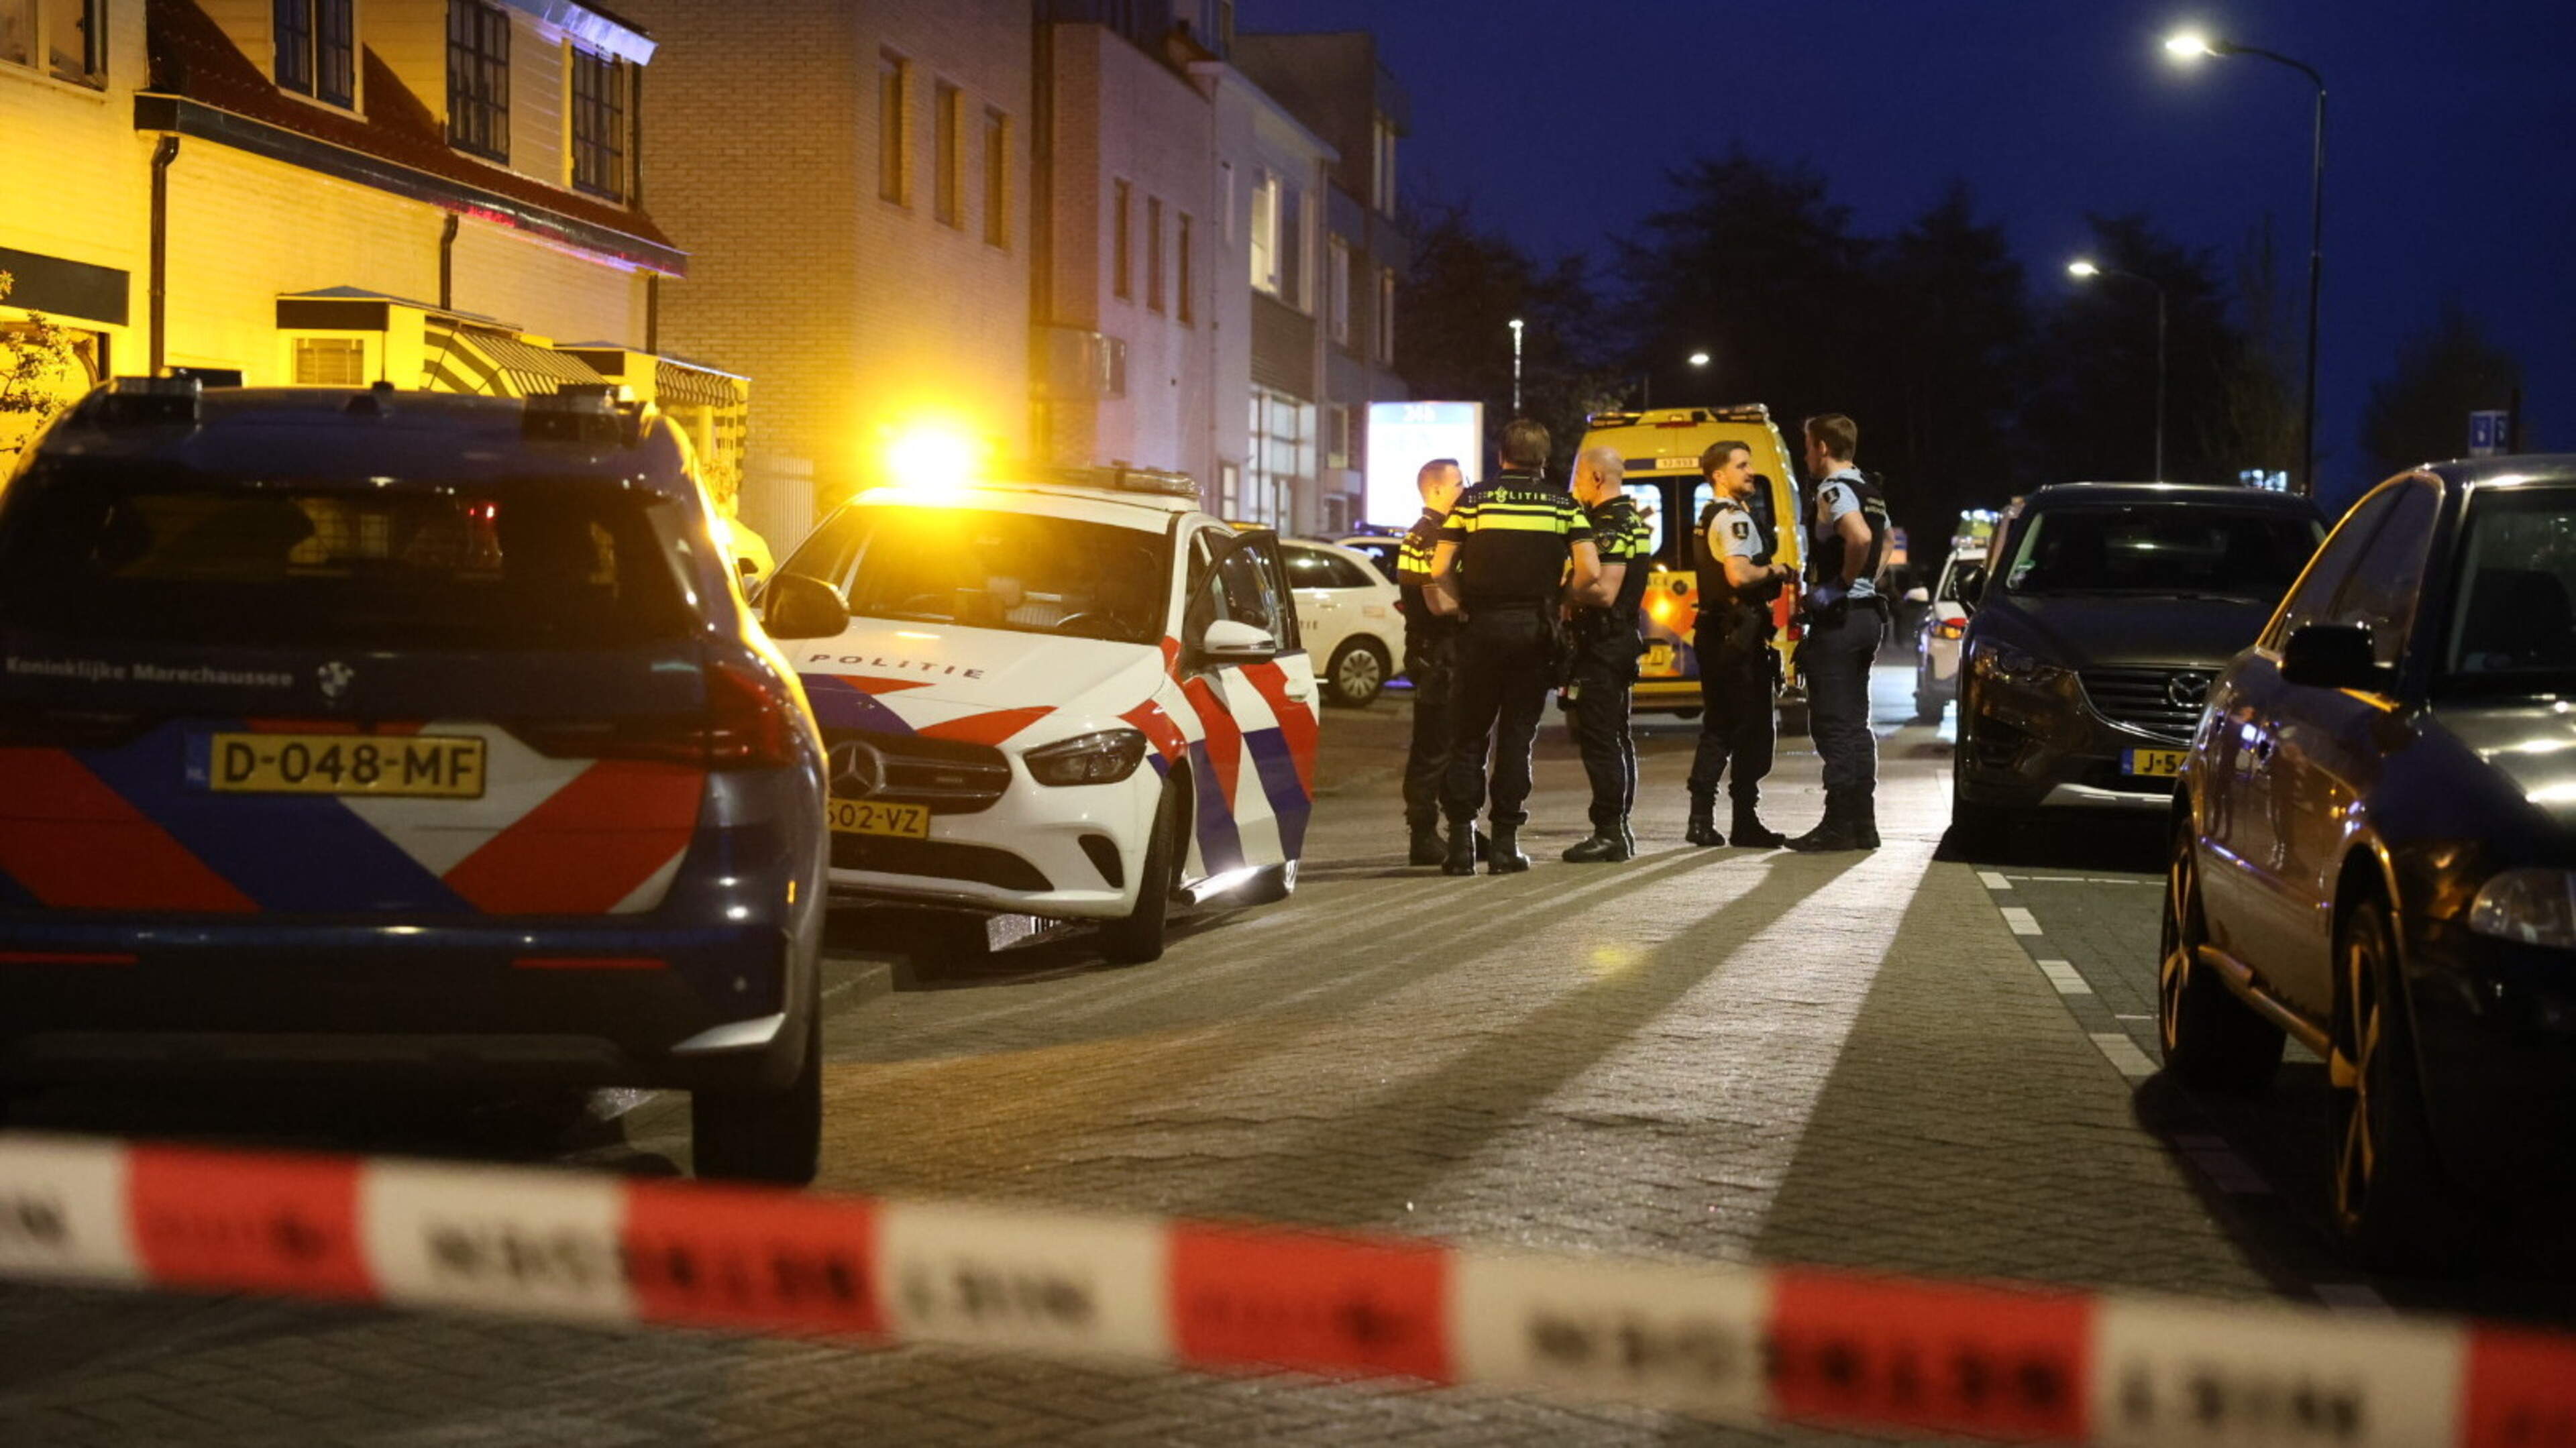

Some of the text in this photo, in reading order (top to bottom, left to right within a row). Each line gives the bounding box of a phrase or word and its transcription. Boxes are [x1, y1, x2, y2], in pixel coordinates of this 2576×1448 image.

[6, 656, 293, 687] Koninklijke Marechaussee
[809, 655, 985, 679] POLITIE
[225, 742, 476, 787] D-048-MF
